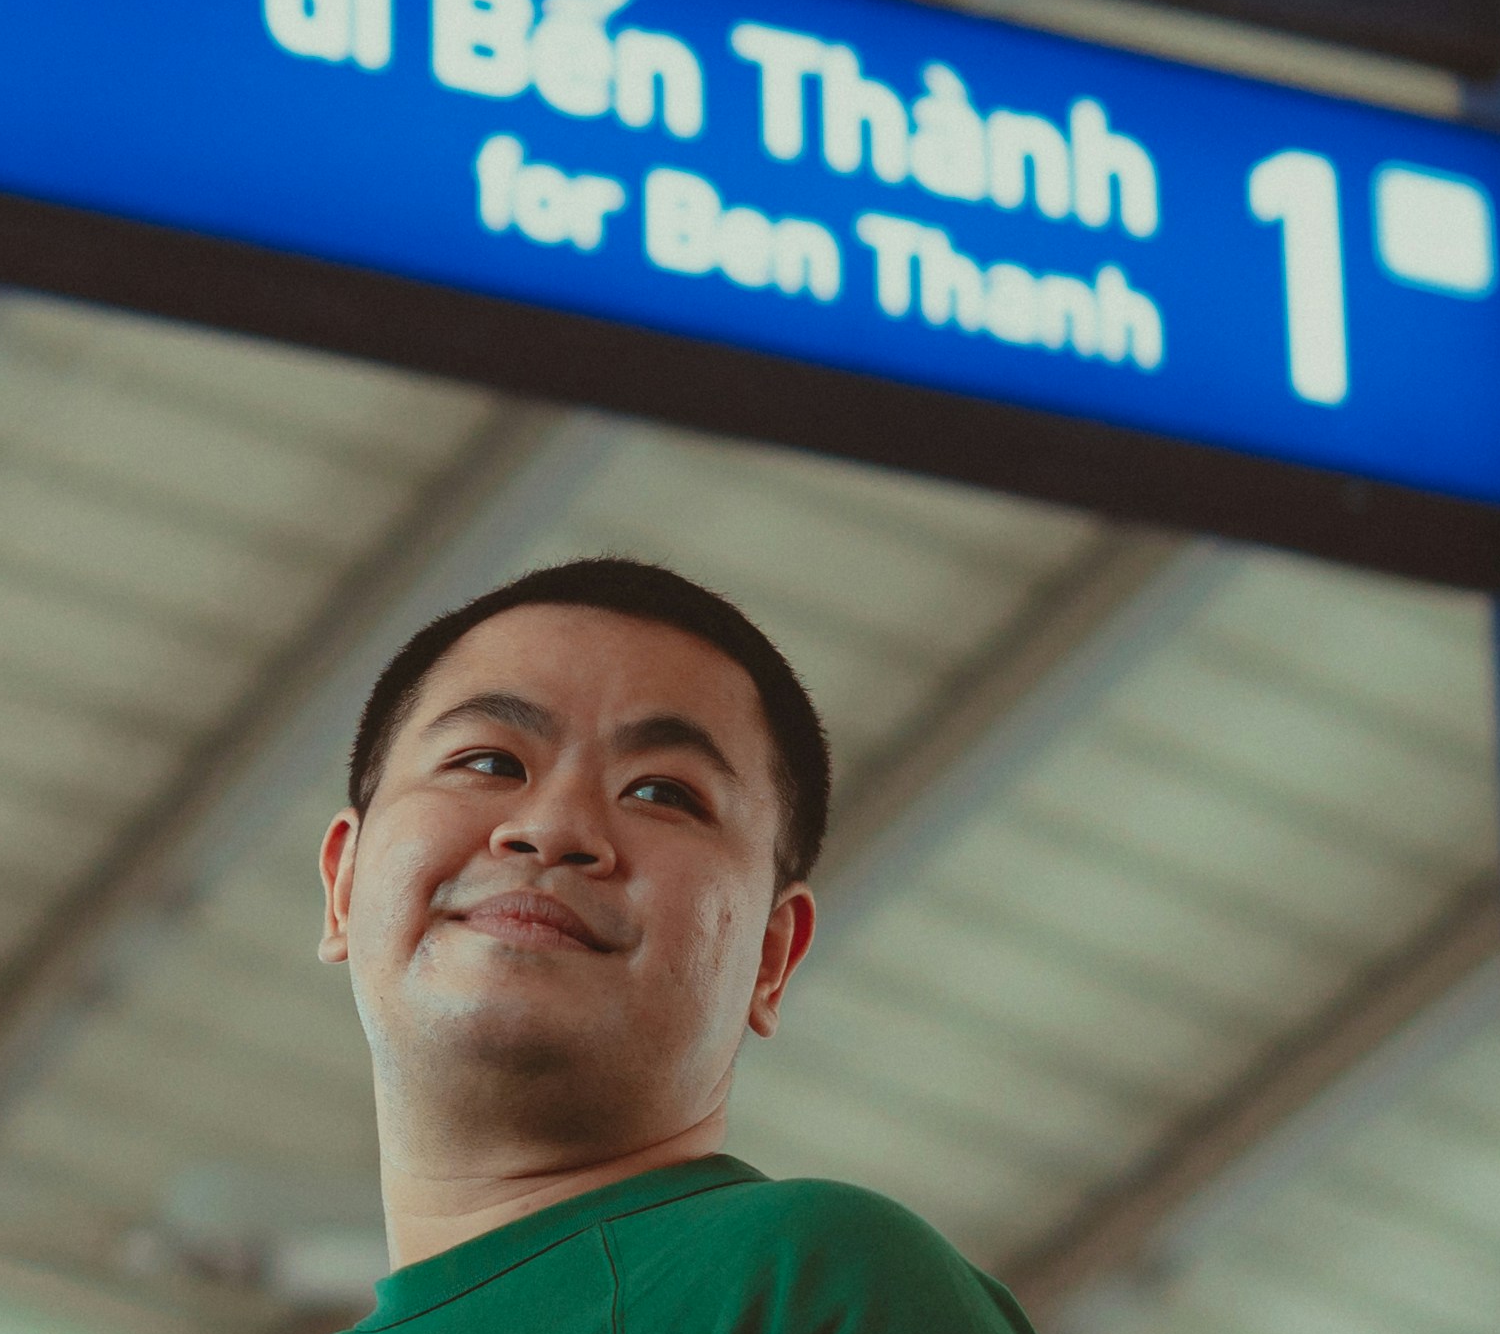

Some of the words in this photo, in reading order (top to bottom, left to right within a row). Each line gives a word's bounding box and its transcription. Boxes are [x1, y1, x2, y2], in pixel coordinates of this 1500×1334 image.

[731, 24, 1158, 238] Thành
[476, 134, 625, 250] for
[644, 168, 841, 301] Ben
[856, 213, 1163, 368] Thanh
[1248, 151, 1348, 404] 1
